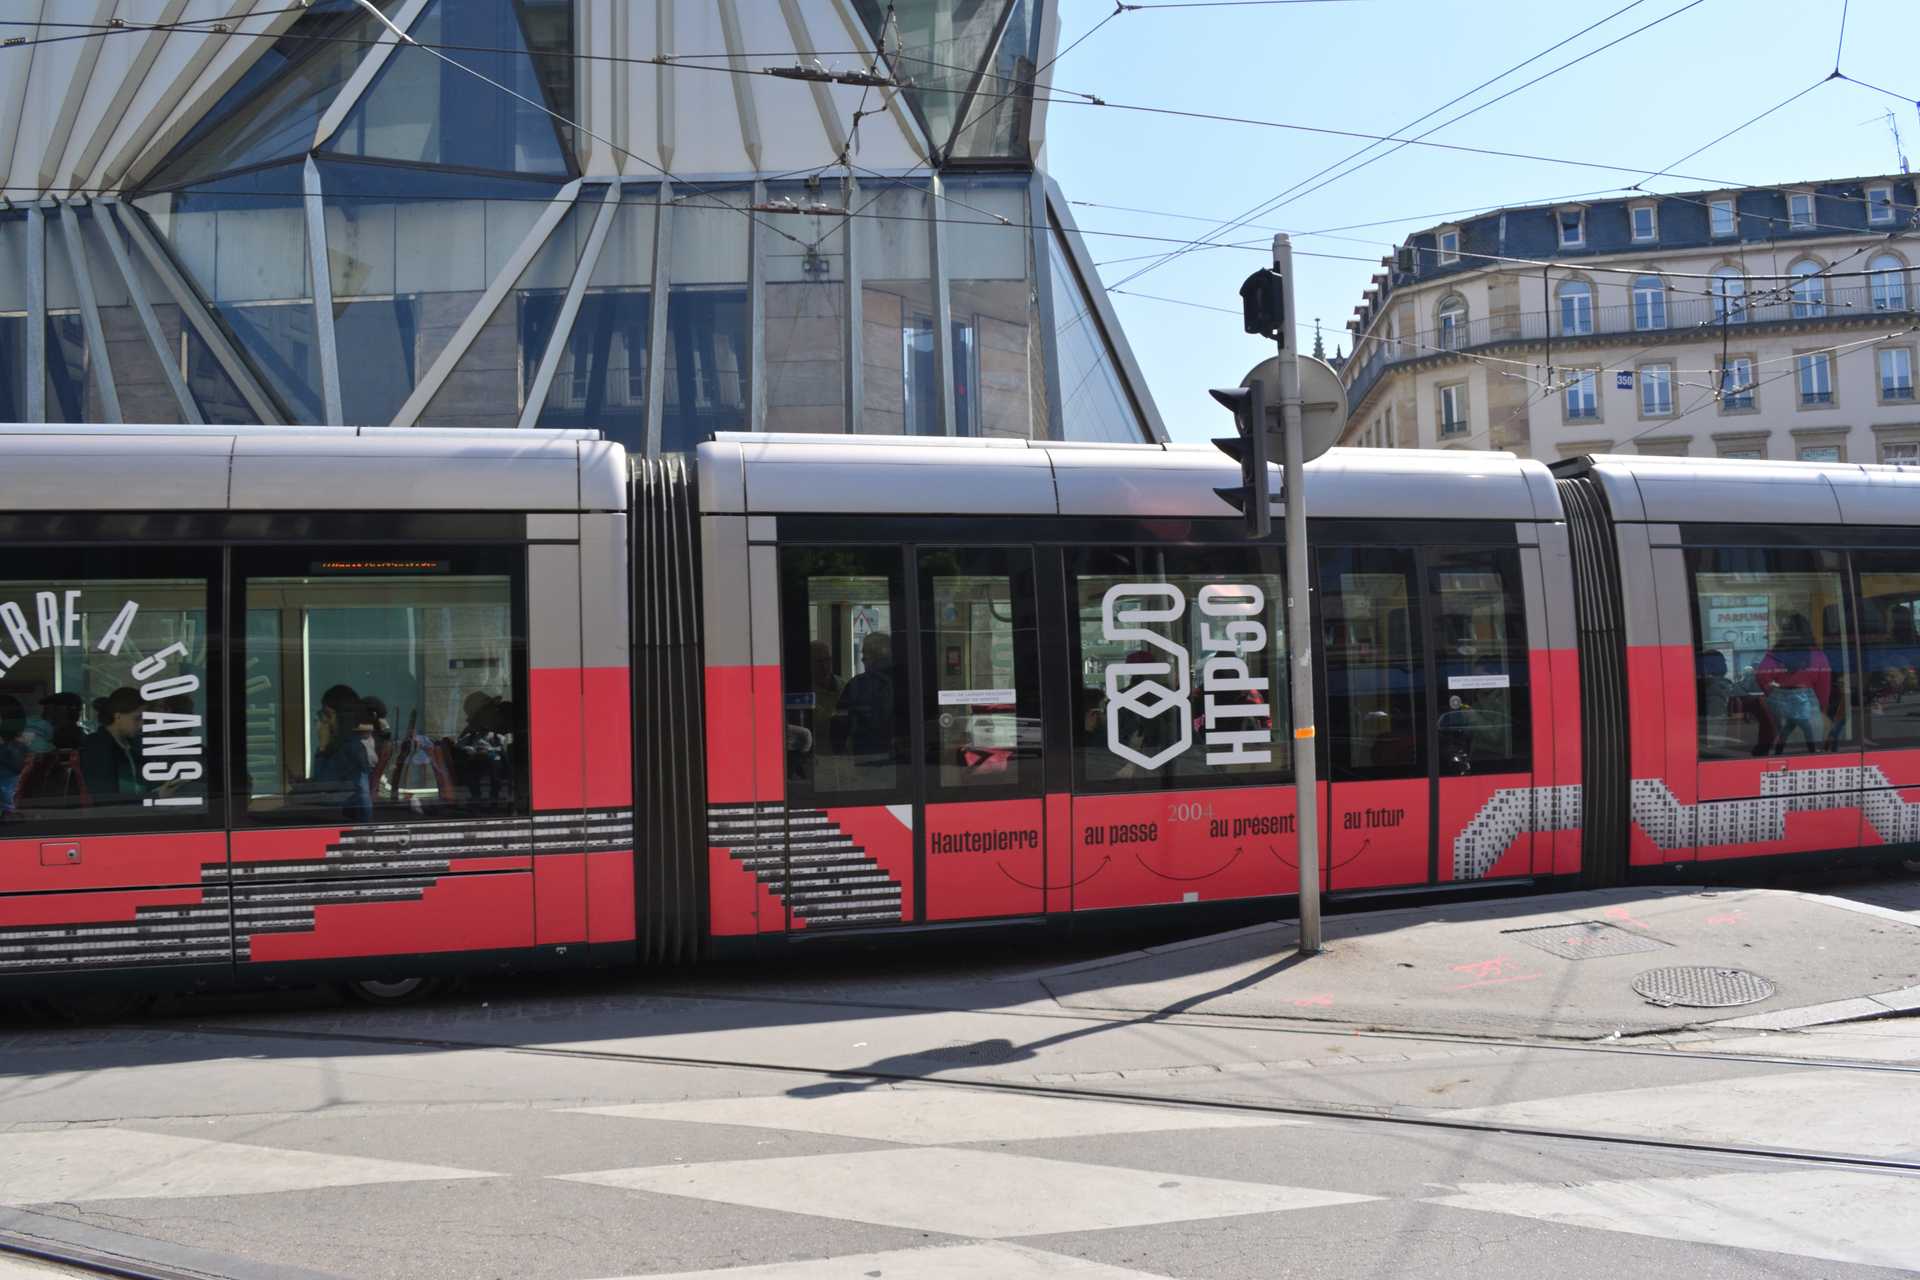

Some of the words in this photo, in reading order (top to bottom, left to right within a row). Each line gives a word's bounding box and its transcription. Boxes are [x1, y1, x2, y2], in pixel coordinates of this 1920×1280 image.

[0, 590, 81, 678] RRE
[97, 600, 139, 656] A
[1199, 585, 1272, 766] HTP50
[931, 829, 1039, 854] Hautepierre
[1084, 825, 1104, 846] au
[1210, 818, 1228, 838] au
[1344, 811, 1361, 829] au
[1366, 807, 1405, 828] futur
[1168, 801, 1213, 822] 2004
